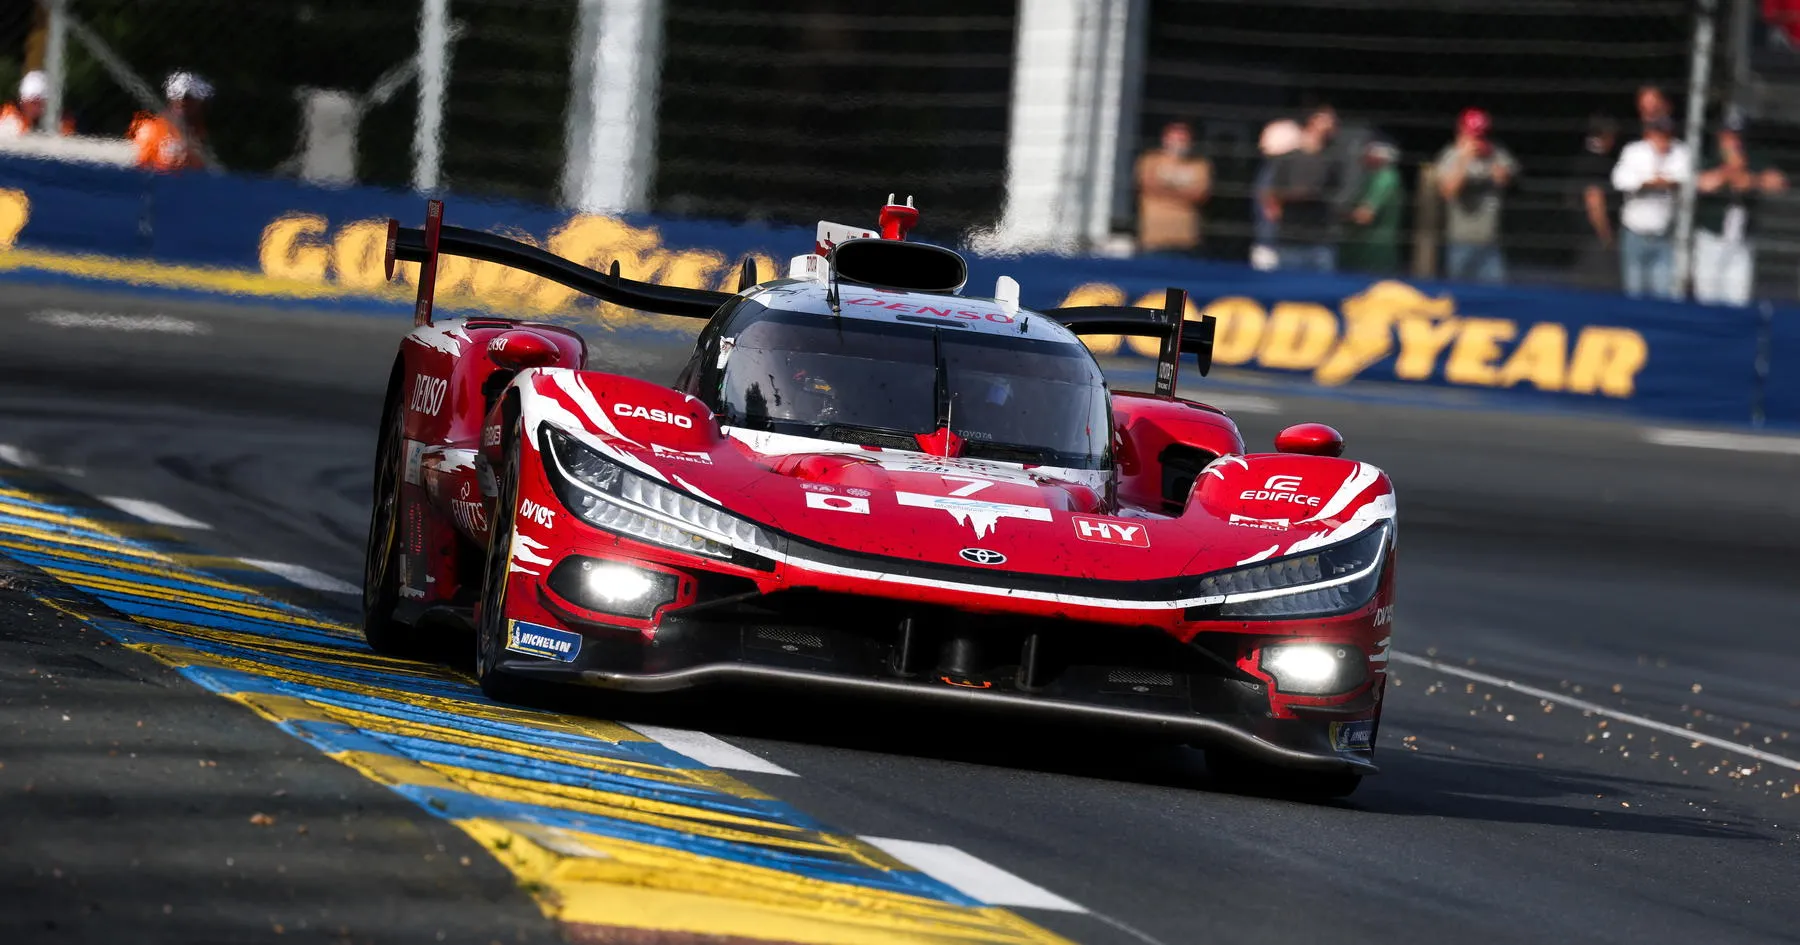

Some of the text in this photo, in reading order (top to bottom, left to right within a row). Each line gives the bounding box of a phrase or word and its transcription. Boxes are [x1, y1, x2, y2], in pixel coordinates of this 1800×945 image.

[846, 297, 1015, 325] DENSO
[487, 338, 508, 351] ENSO
[411, 373, 448, 417] DENSO
[613, 403, 692, 429] CASIO
[655, 452, 713, 465] MARELLI
[940, 475, 994, 497] 7
[1240, 490, 1320, 507] EDIFICE
[1079, 521, 1140, 542] HY
[1228, 521, 1288, 531] MARELLI
[520, 632, 572, 654] MICHELIN
